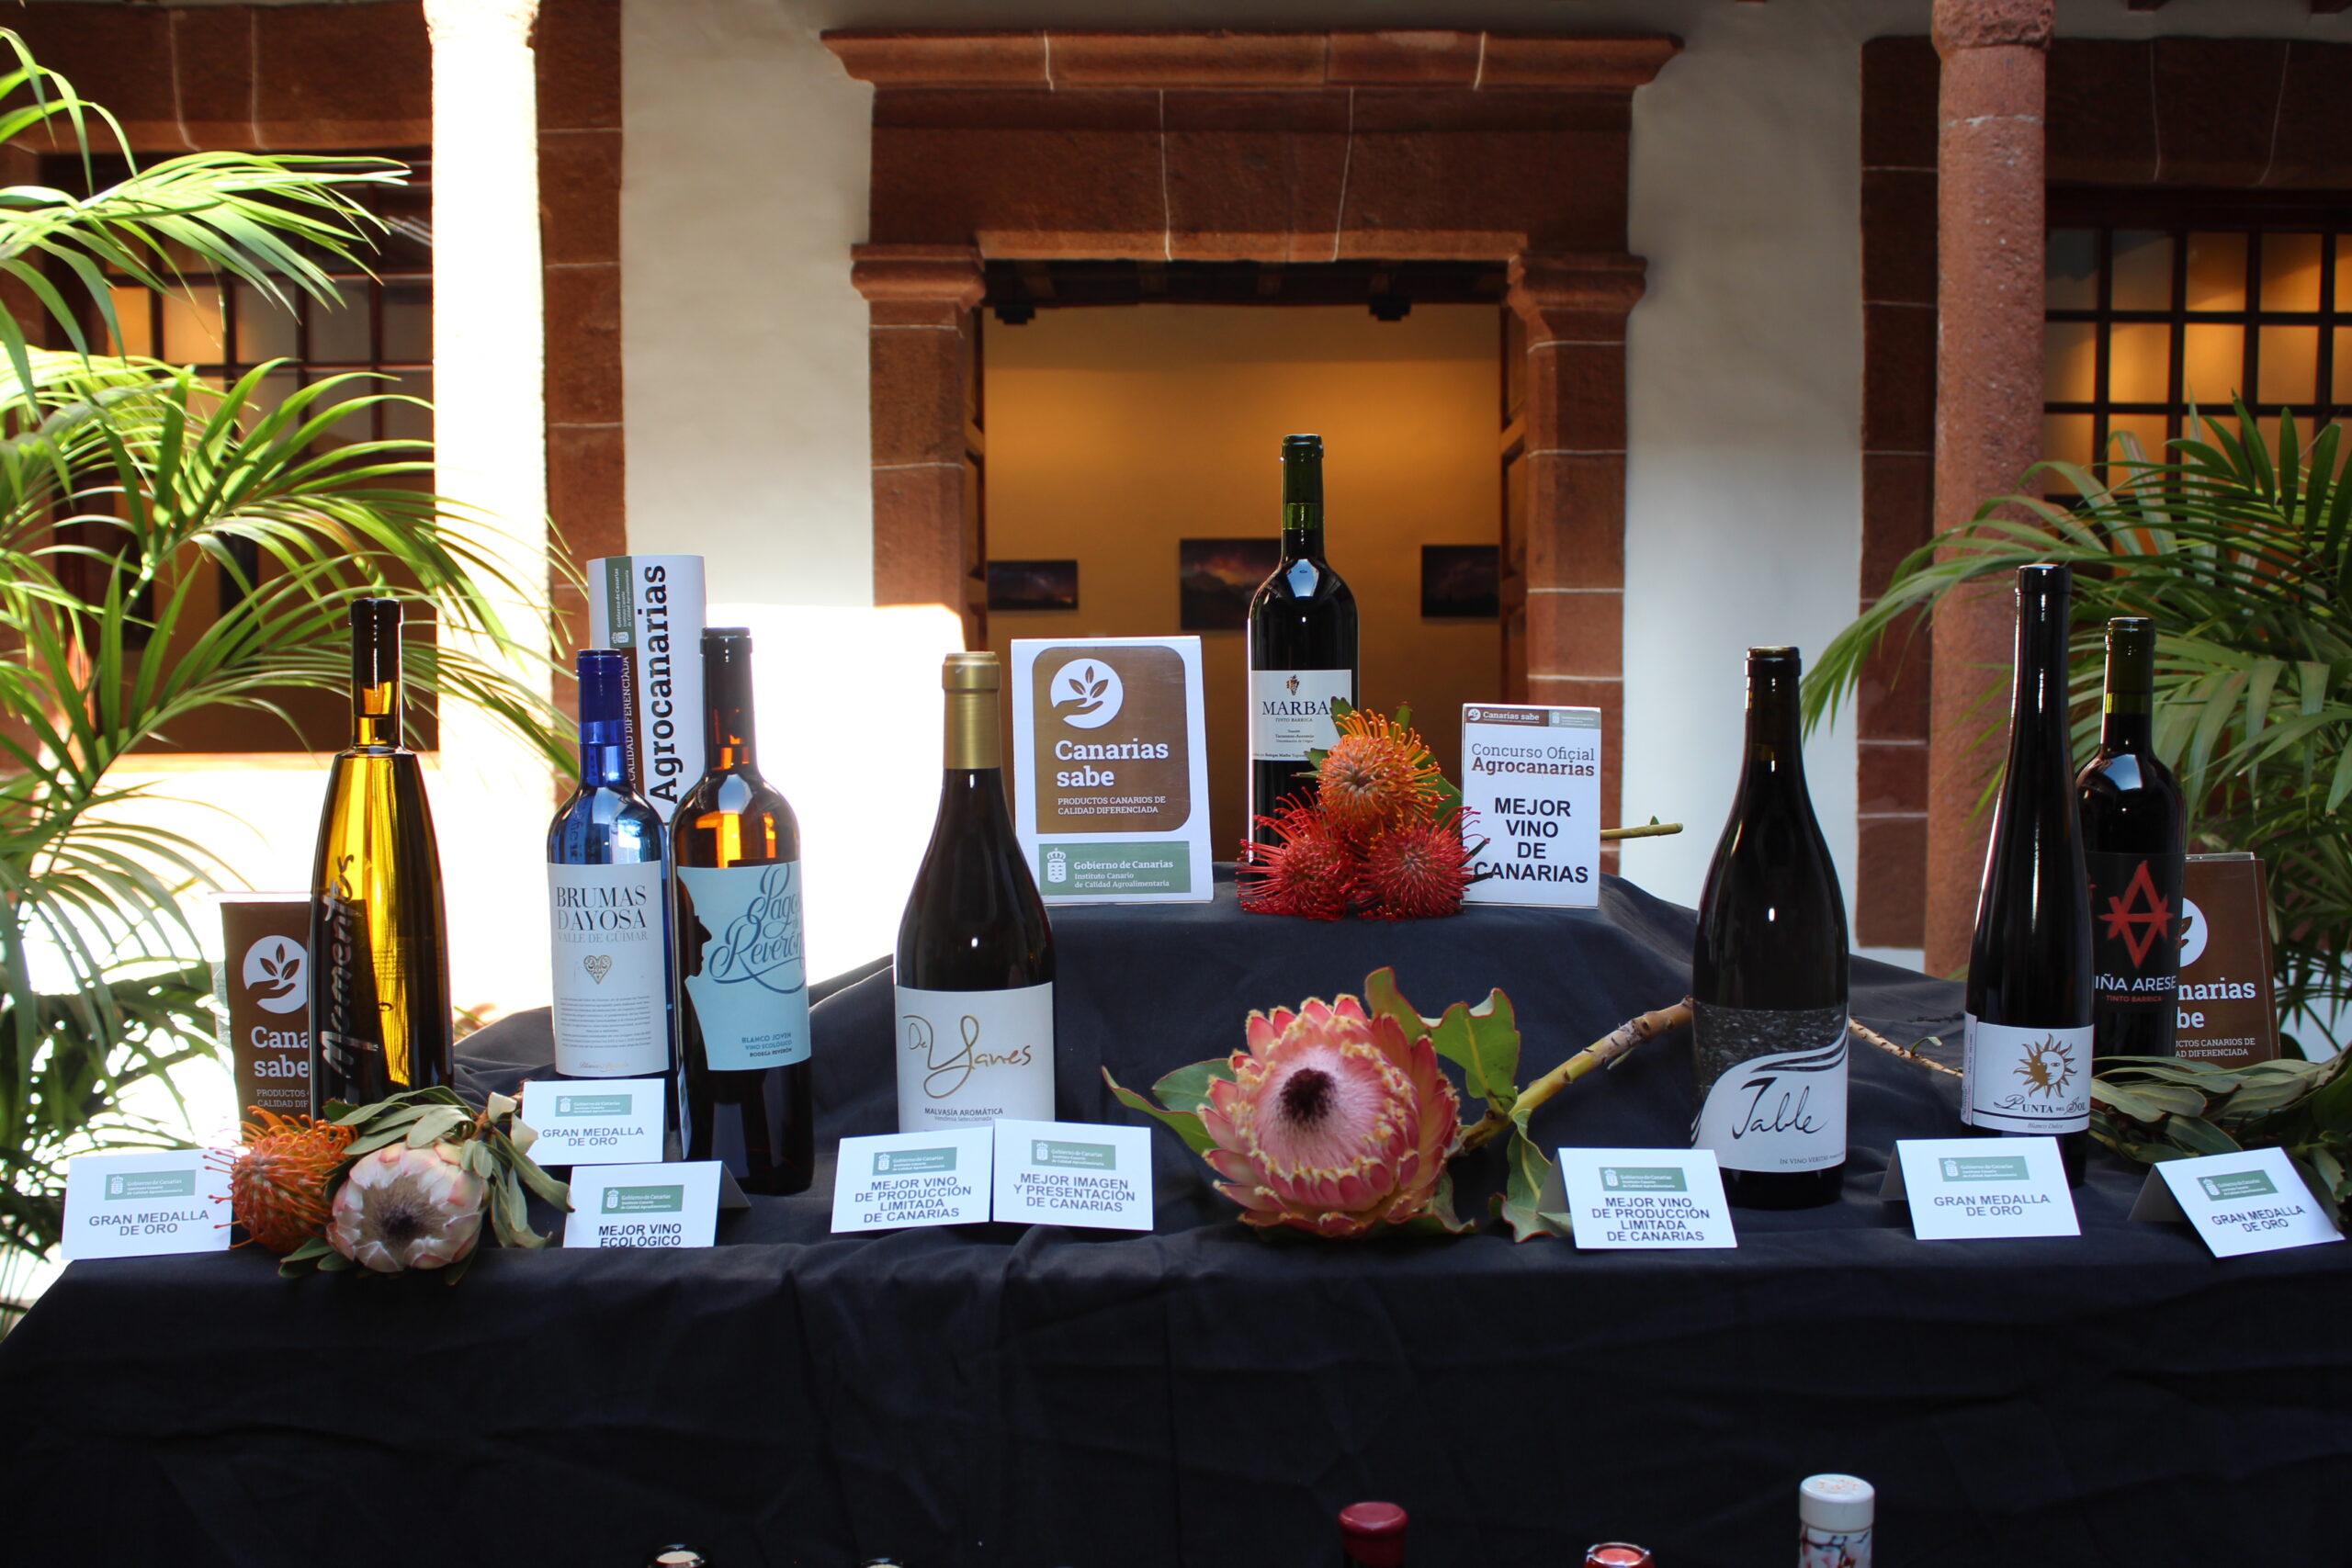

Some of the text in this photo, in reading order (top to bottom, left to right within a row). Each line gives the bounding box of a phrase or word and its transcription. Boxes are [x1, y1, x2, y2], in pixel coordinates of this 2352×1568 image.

[638, 565, 683, 804] Agrocanarias
[1262, 701, 1329, 715] MARBA
[1483, 711, 1540, 721] Canarias sabe
[1055, 738, 1169, 761] Canarias
[1471, 743, 1595, 761] Concurso Oficial
[626, 735, 636, 781] CALIDAD
[1471, 756, 1595, 777] Agrocanarias
[1057, 765, 1114, 787] sabe
[1110, 796, 1153, 805] CANARIOS
[1155, 795, 1166, 804] DE
[1494, 797, 1571, 817] MEJOR
[1057, 806, 1159, 815] CALIDAD DIFERENCIADA
[1506, 819, 1559, 838] VINO
[1517, 841, 1546, 859] DE
[1074, 860, 1173, 870] Gobierno de Canarias
[1474, 861, 1589, 884] CANARIAS
[1113, 880, 1170, 889] Agroalimentaria
[556, 885, 647, 908] BRUMAS
[557, 908, 647, 931] DAYOSA
[2095, 974, 2177, 991] IÑA ARESE
[2178, 977, 2256, 1000] narias
[2177, 1007, 2205, 1029] be
[251, 1026, 309, 1048] Cana
[741, 1035, 770, 1043] BLANCO
[2200, 1038, 2243, 1046] CANARIOS
[903, 1015, 1032, 1099] De Yanes
[2188, 1048, 2248, 1057] DIFERENCIADA
[254, 1055, 309, 1077] sabe
[256, 1089, 306, 1098] PRODUCTOS
[257, 1100, 293, 1108] CALIDAD
[1994, 1094, 2053, 1113] PUNTA
[924, 1107, 1003, 1116] MALVASÍA AROMÁTICA
[542, 1126, 644, 1138] GRAN MEDALLA
[568, 1136, 618, 1146] DE ORO
[871, 1177, 957, 1190] MEJOR VINO
[1020, 1173, 1128, 1190] MEJOR IMAGEN
[854, 1185, 971, 1202] DE PRODUCCIÓN
[1013, 1184, 1136, 1201] Y PRESENTACIÓN
[1934, 1194, 2051, 1206] GRAN MEDALLA
[880, 1199, 944, 1212] LIMITADA
[1026, 1197, 1123, 1213] DE CANARIAS
[1605, 1198, 1692, 1208] MEJOR VINO
[1966, 1205, 2023, 1216] DE ORO
[89, 1210, 209, 1226] GRAN MEDALLA
[864, 1208, 960, 1224] DE CANARIAS
[1591, 1206, 1710, 1219] DE PRODUCCIÓN
[2211, 1205, 2306, 1225] GRAN MEDALLA
[119, 1223, 178, 1236] DE ORO
[598, 1224, 682, 1235] MEJOR VINO
[1621, 1220, 1687, 1230] LIMITADA
[2242, 1218, 2289, 1233] DE ORO
[600, 1235, 682, 1247] ECOLÓGICO
[1607, 1231, 1705, 1241] DE CANARIAS
